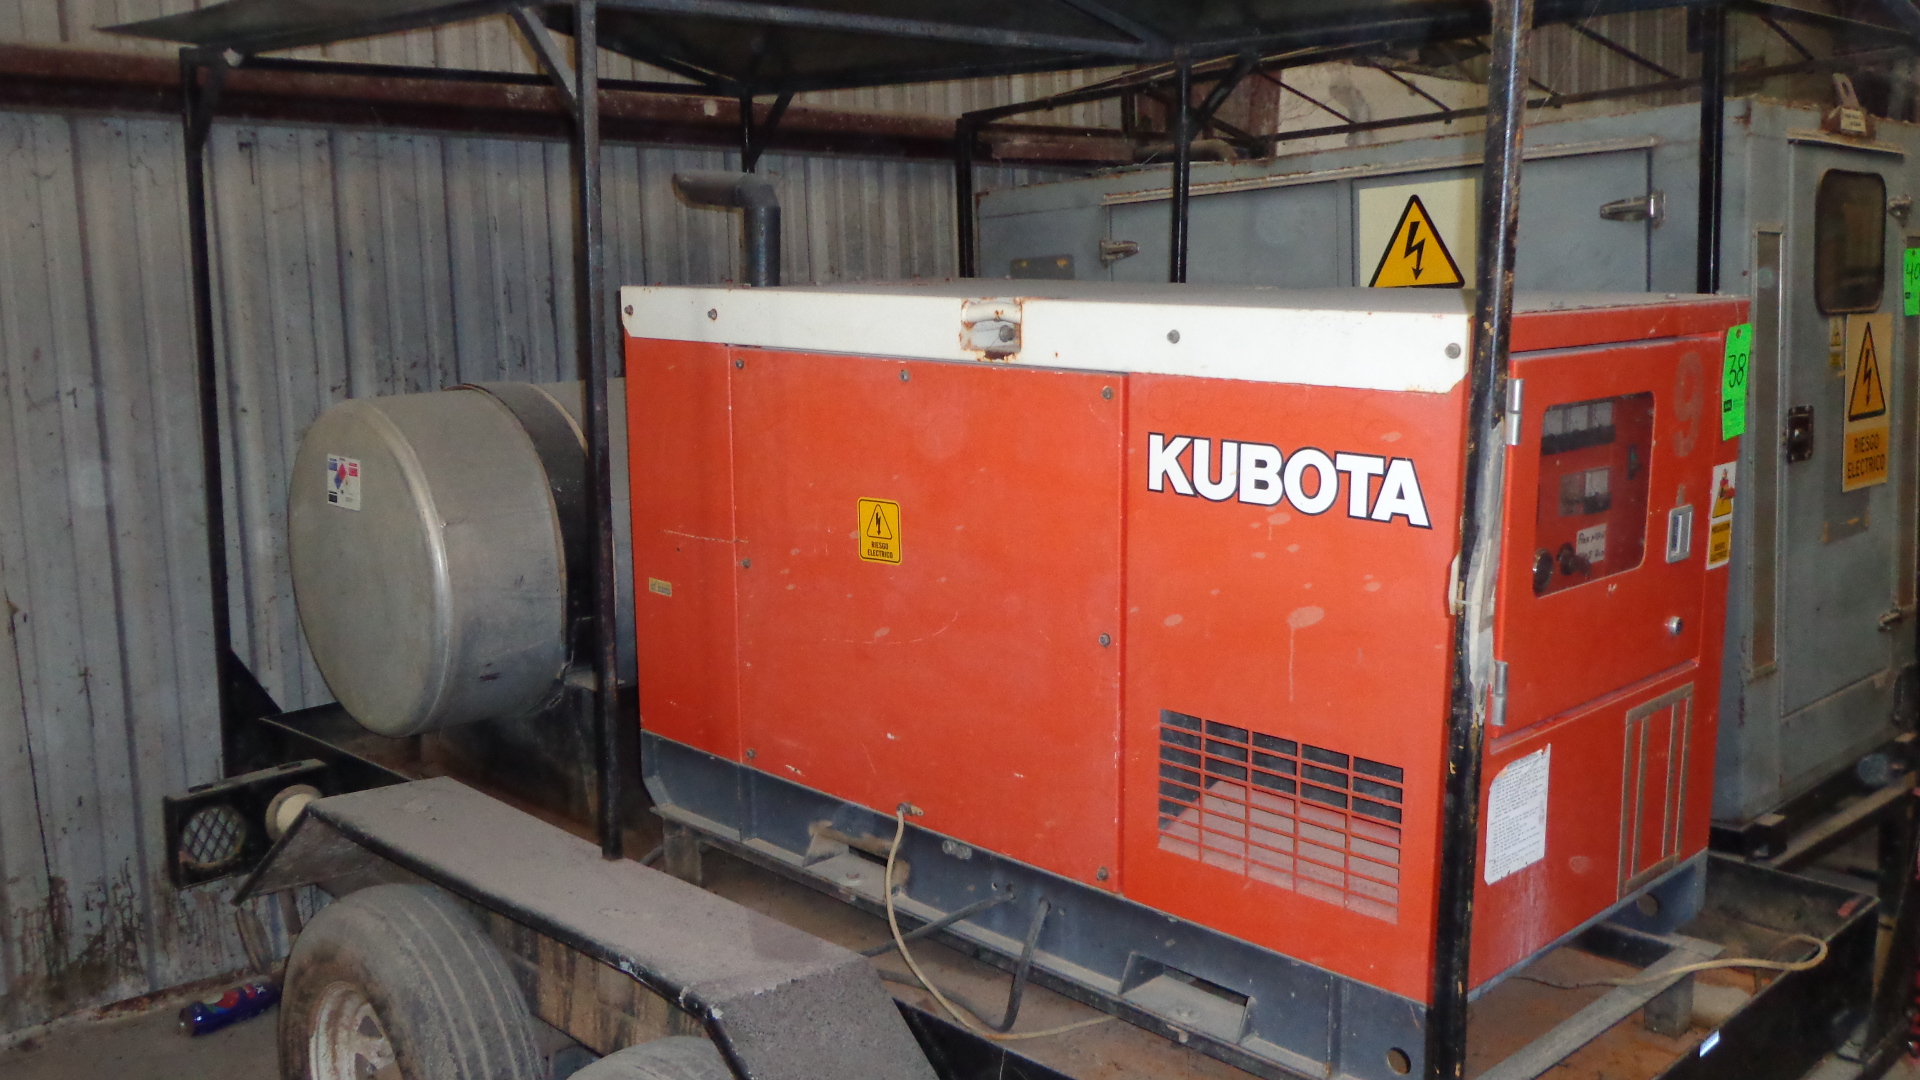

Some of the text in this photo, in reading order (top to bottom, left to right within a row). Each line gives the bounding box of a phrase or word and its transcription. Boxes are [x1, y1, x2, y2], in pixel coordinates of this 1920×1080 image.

[1729, 353, 1747, 388] 38
[1672, 350, 1704, 457] 9
[1853, 433, 1880, 453] RIESGO
[1847, 454, 1886, 479] ELECTRICO
[1147, 431, 1433, 530] KUBOTA
[867, 549, 893, 559] ELECTRICO
[871, 541, 888, 550] RIESGO
